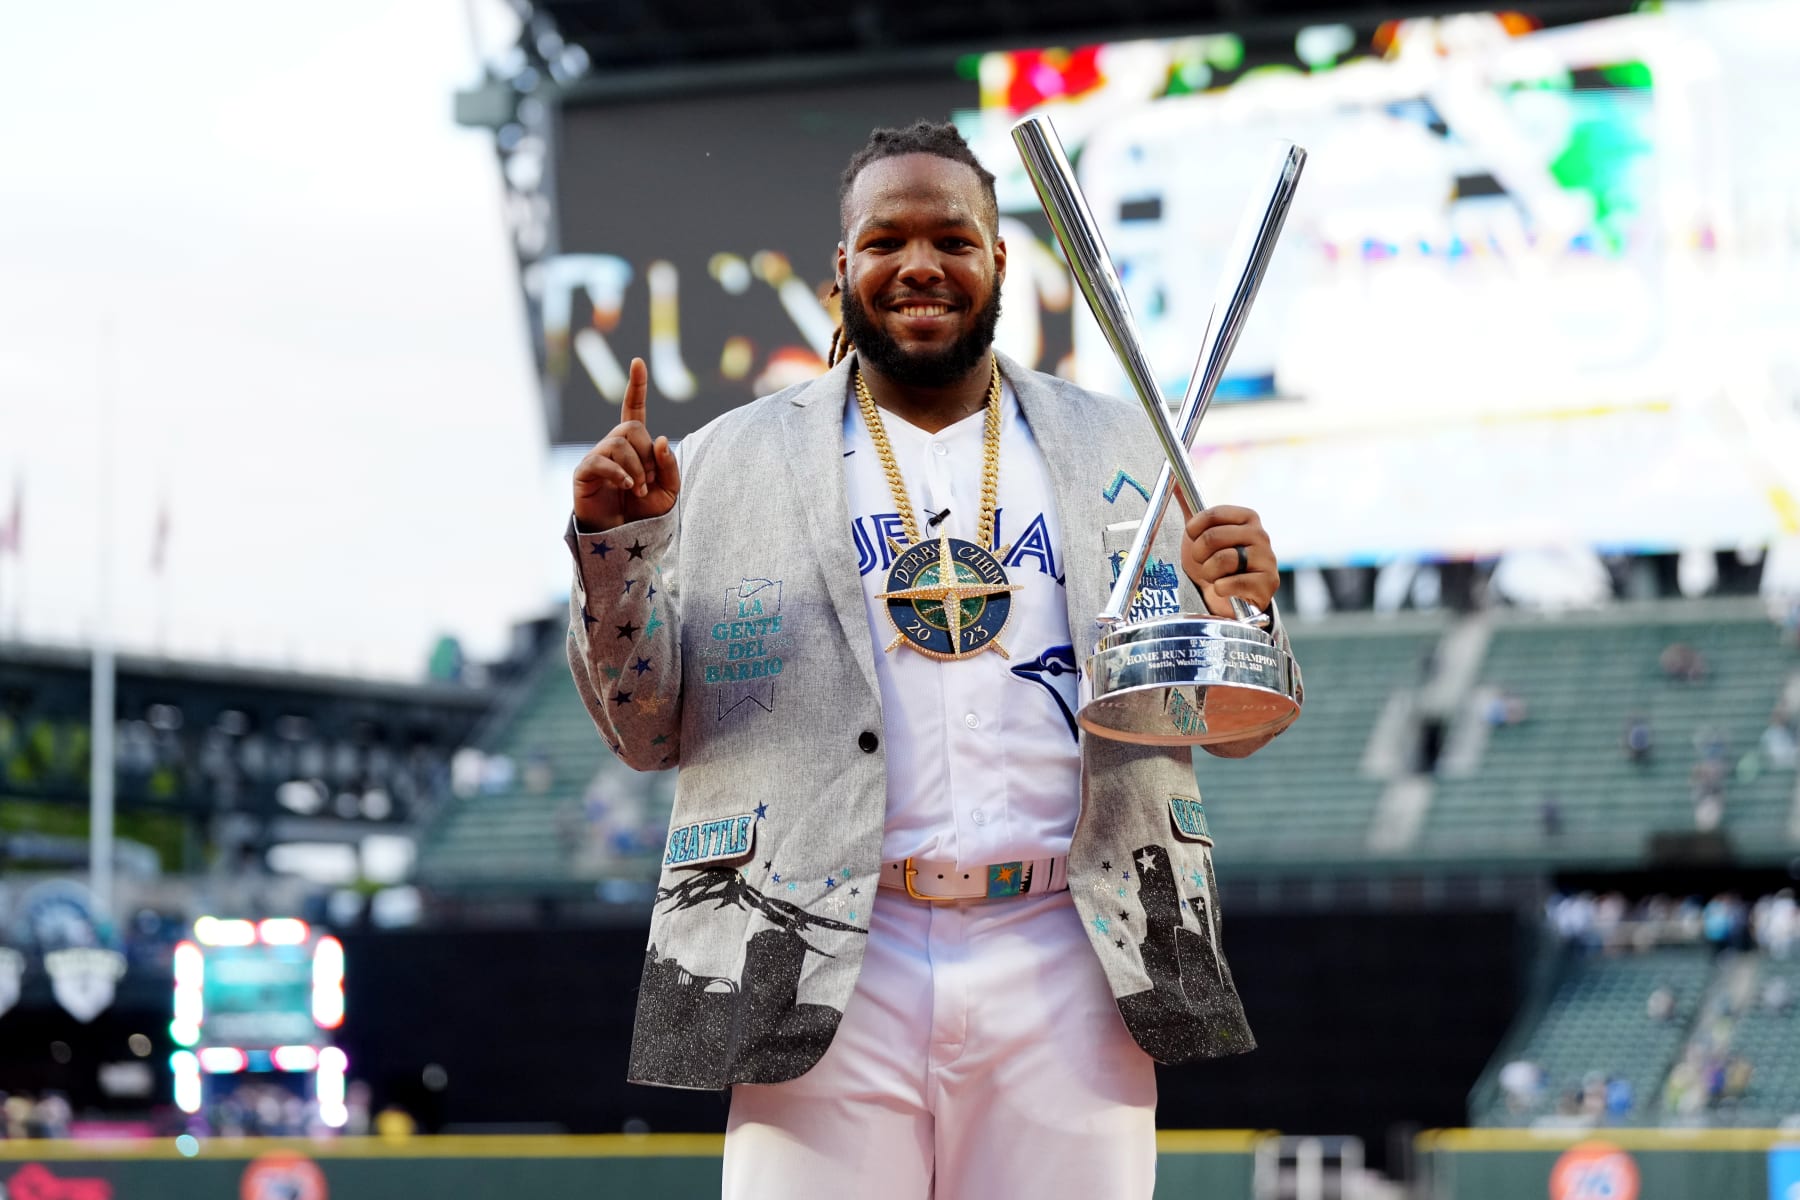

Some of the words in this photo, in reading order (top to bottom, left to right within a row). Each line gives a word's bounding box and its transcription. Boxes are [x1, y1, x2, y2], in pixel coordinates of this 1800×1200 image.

[737, 599, 764, 618] LA
[712, 616, 782, 640] GENTE
[906, 619, 932, 642] 20
[963, 624, 989, 646] 23
[728, 641, 767, 661] DEL
[1126, 652, 1158, 665] HOME
[1163, 650, 1186, 659] RUN
[1230, 651, 1277, 667] CHAMPION
[705, 657, 783, 683] BARRIO
[665, 816, 751, 864] SEATTLE
